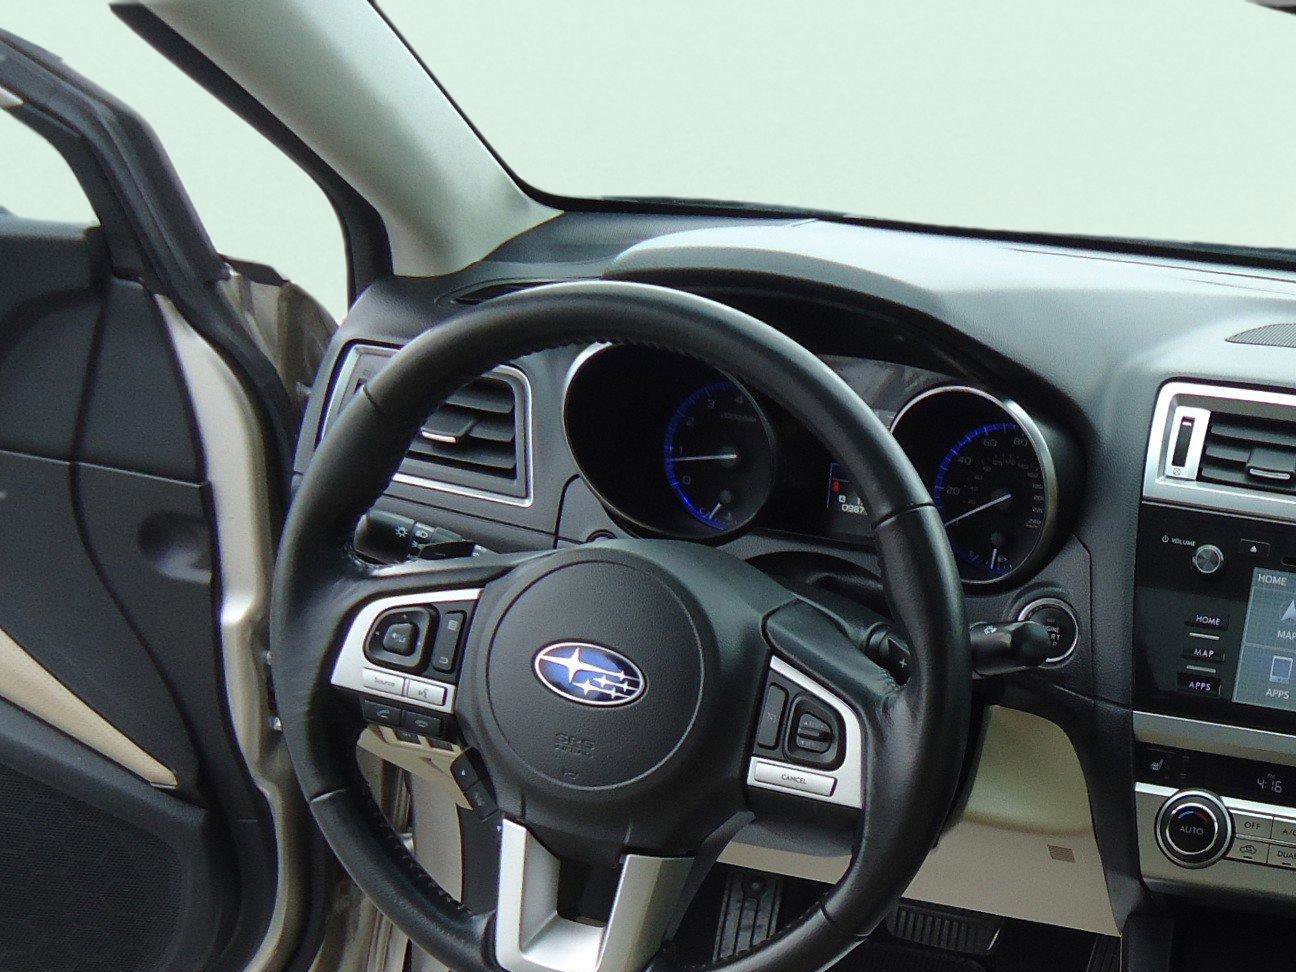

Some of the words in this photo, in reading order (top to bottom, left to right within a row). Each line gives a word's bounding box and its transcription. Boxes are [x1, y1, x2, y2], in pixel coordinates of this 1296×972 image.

[1258, 574, 1287, 586] HOME
[1195, 615, 1221, 626] HOME
[1193, 648, 1214, 658] MAP
[1188, 681, 1211, 691] APPS
[1265, 688, 1290, 699] APPS
[781, 773, 807, 785] CANCEL
[1180, 825, 1204, 835] AUTO
[1244, 821, 1261, 830] OFF
